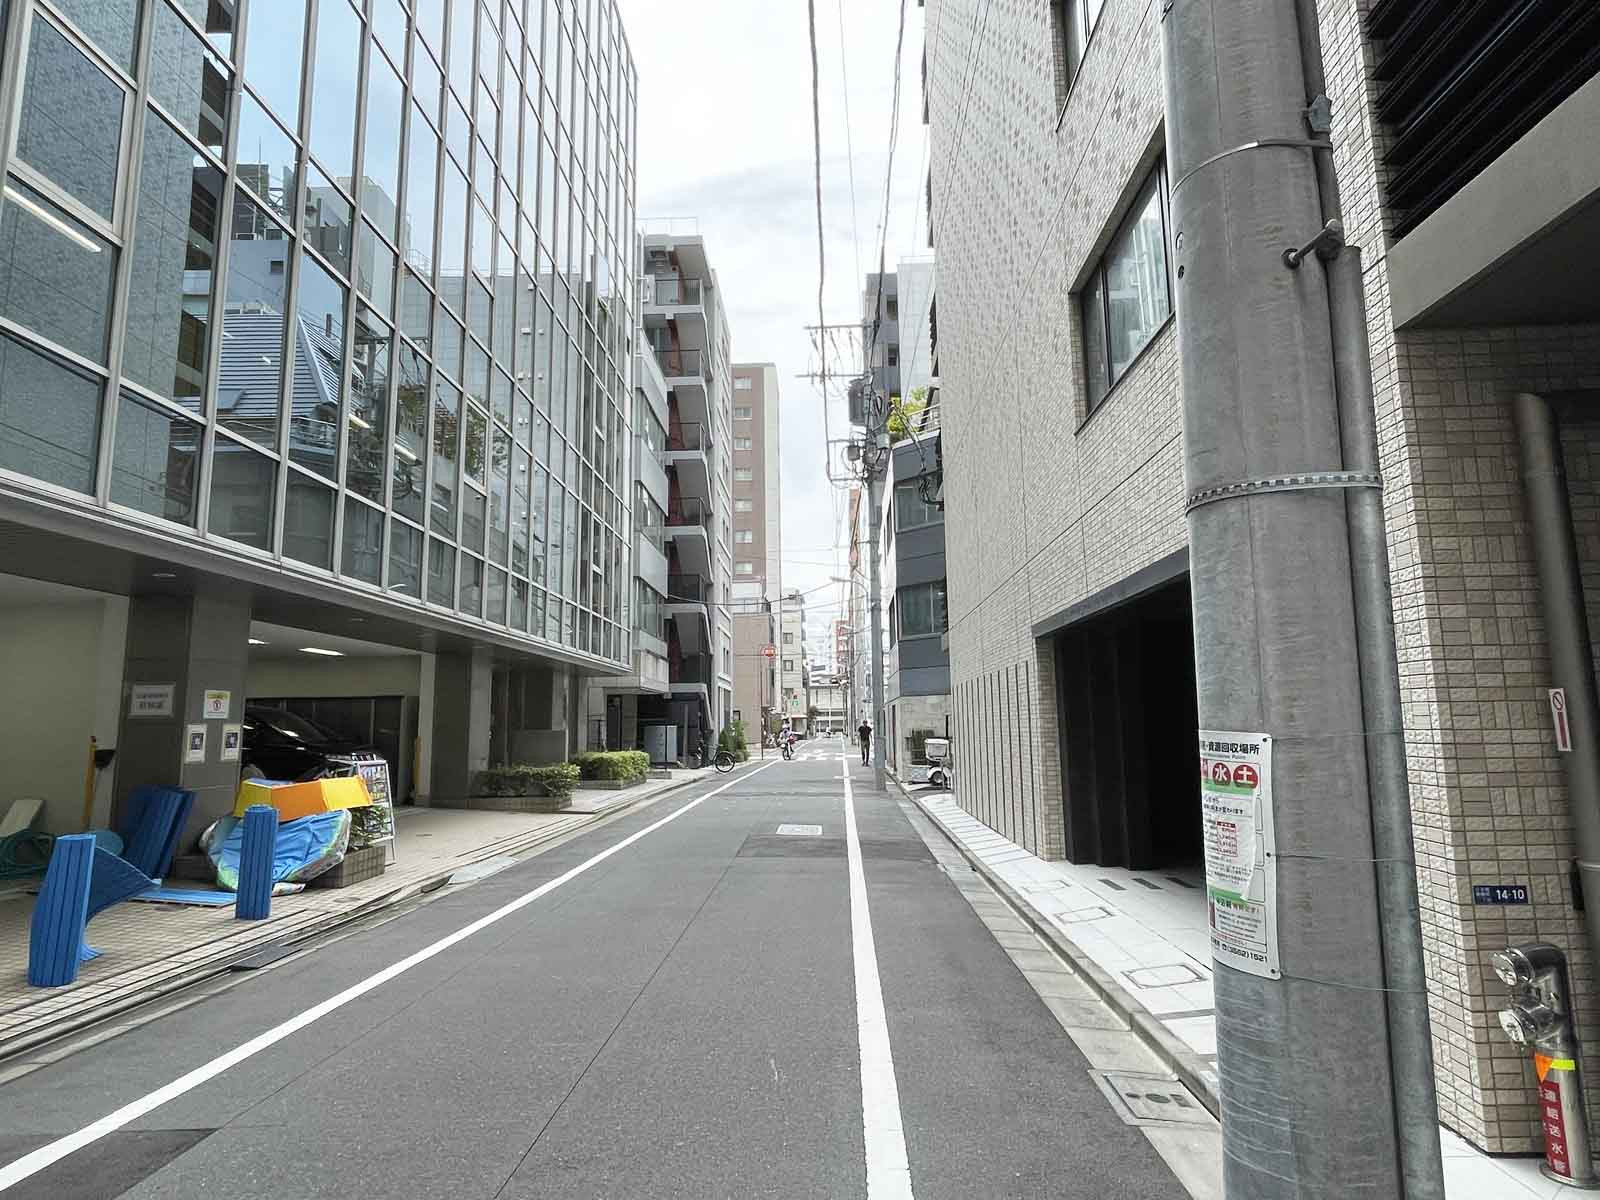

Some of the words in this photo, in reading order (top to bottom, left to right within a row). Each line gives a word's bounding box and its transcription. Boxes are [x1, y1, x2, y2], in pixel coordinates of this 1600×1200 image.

[1214, 764, 1228, 782] 水
[1236, 766, 1254, 785] 土
[1496, 889, 1525, 900] 14-10
